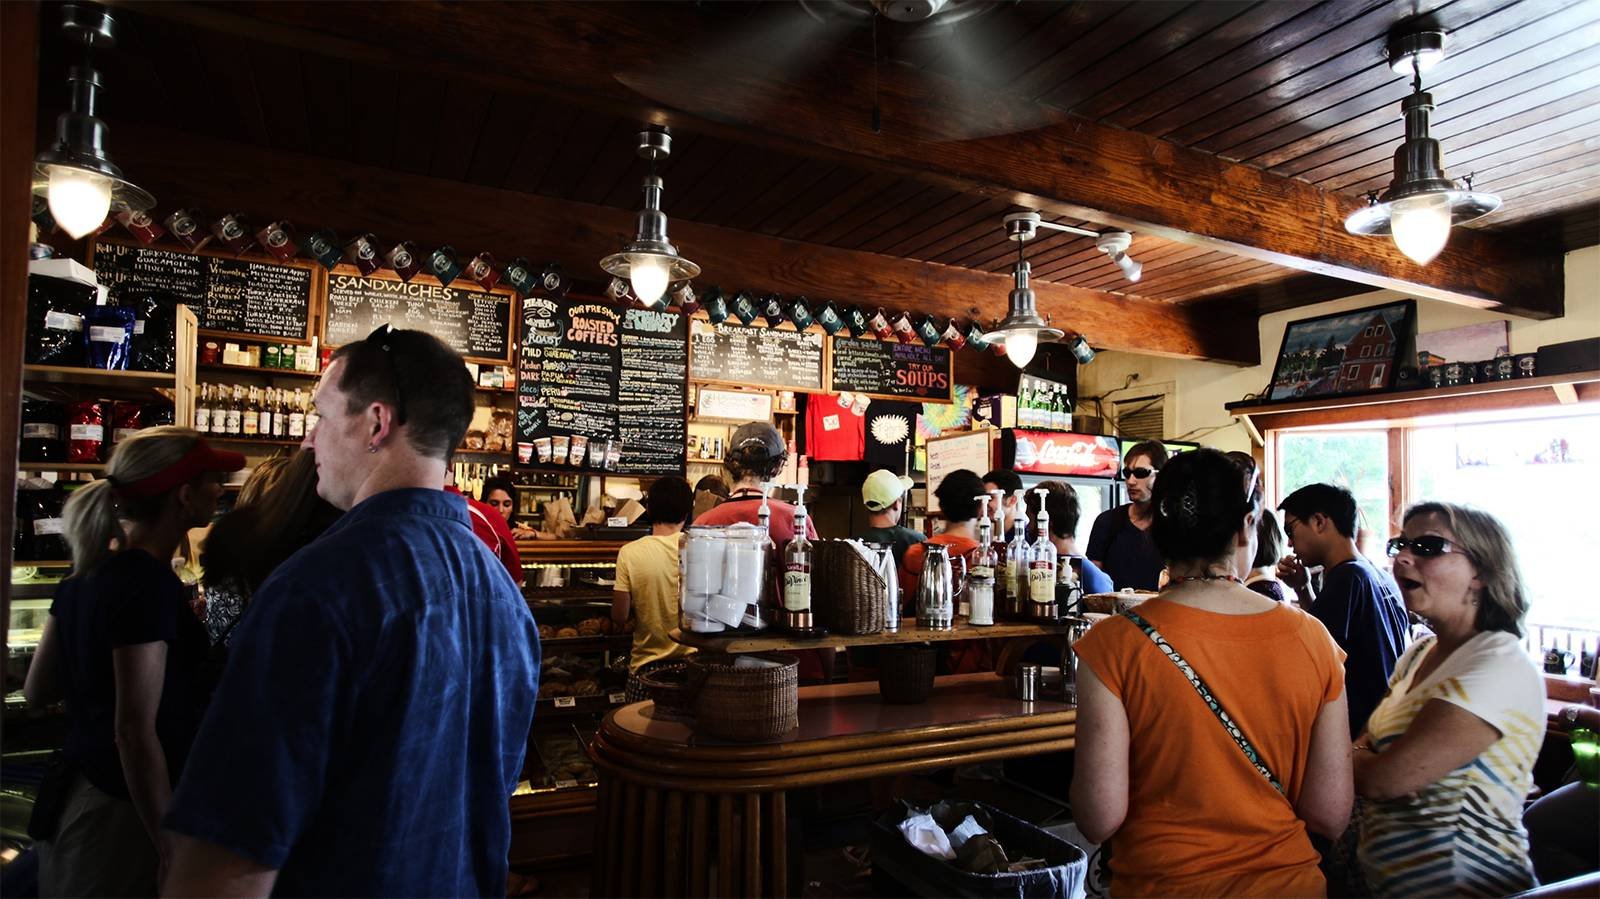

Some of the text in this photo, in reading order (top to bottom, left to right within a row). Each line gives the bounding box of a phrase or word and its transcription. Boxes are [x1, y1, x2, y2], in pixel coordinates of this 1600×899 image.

[335, 276, 453, 301] SANDWICHES
[568, 304, 584, 318] OUR
[585, 304, 621, 325] FRESHLY
[573, 316, 615, 334] ROASTED
[717, 322, 758, 337] BREAKFAST
[566, 328, 619, 347] COFFEES
[522, 346, 541, 358] MILD
[520, 371, 541, 382] DARK
[922, 364, 935, 373] OUR
[896, 368, 948, 390] SOUPS
[541, 386, 562, 397] PERU
